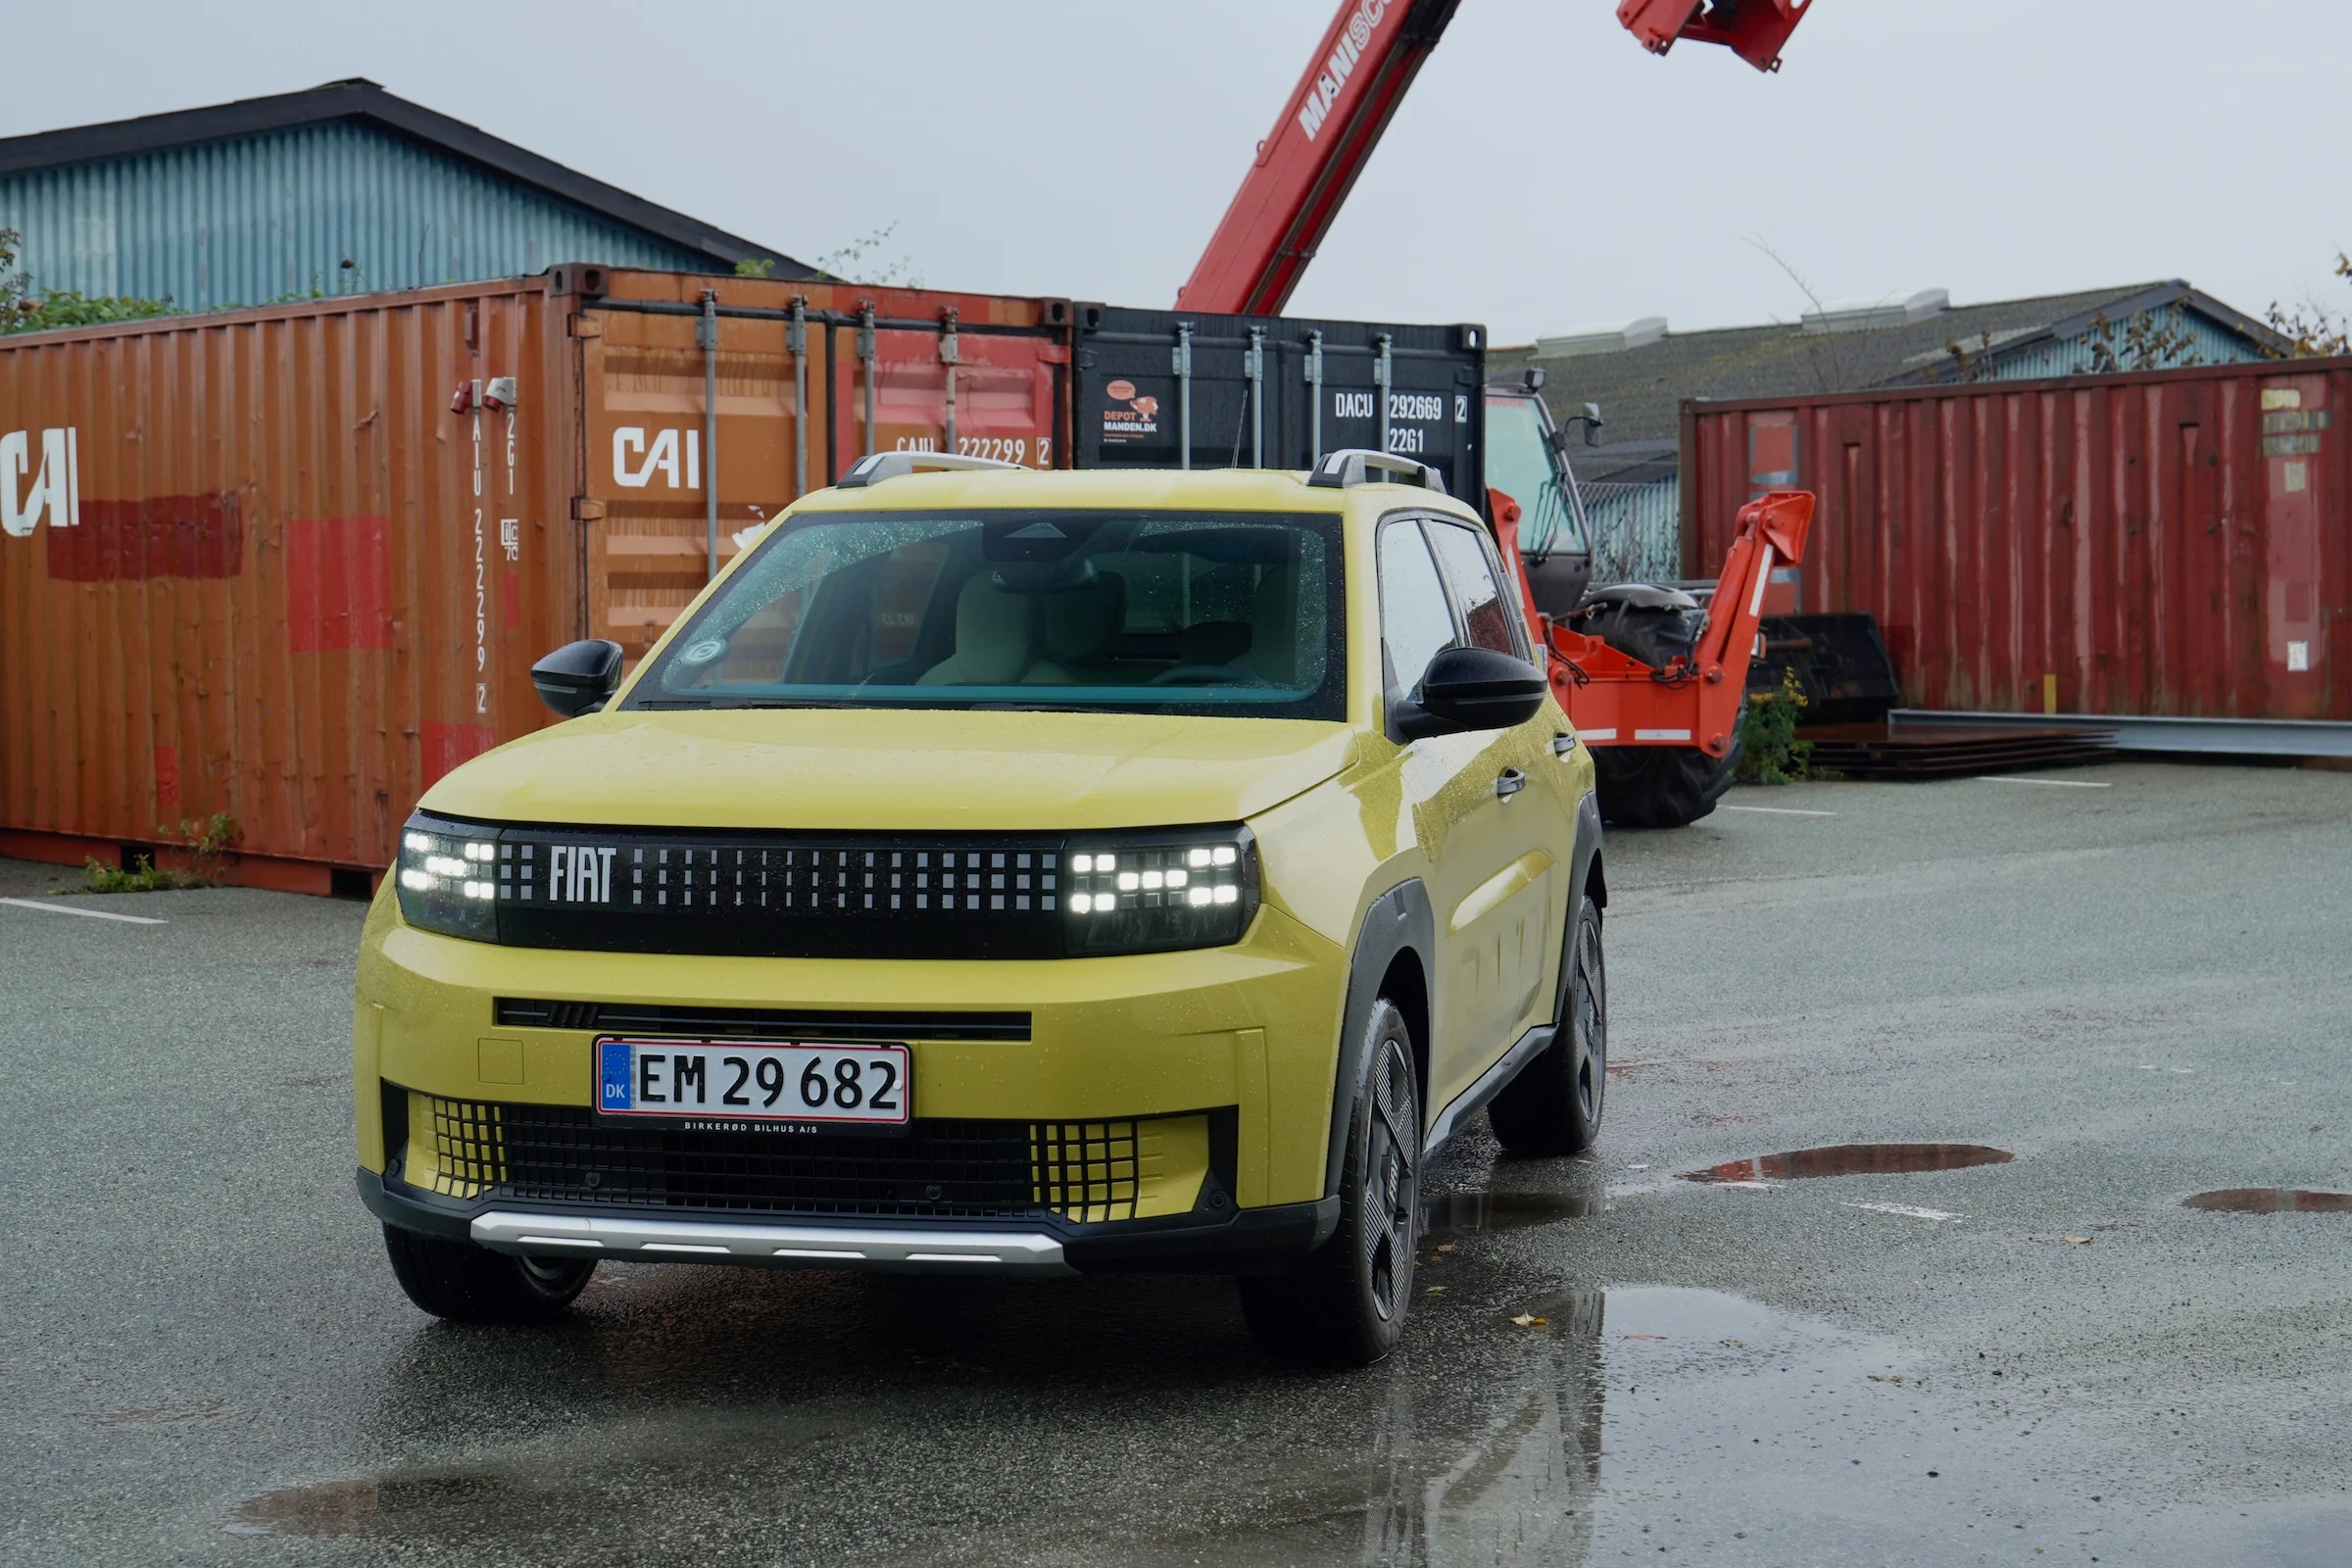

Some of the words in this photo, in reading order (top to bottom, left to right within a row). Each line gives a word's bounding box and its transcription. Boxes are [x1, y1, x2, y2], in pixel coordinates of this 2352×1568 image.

[1298, 0, 1393, 142] MANISC
[1103, 411, 1137, 420] DEPOT
[1103, 421, 1157, 432] MANDEN.DK
[1336, 393, 1373, 417] DACU
[1390, 395, 1443, 420] 292669
[1456, 397, 1466, 421] 2
[472, 416, 482, 496] AIU
[507, 414, 515, 494] 2G1
[612, 426, 700, 489] CAI
[1039, 439, 1050, 466] 2
[1390, 428, 1424, 453] 22G1
[0, 427, 80, 537] CAI
[475, 509, 486, 672] 222299
[478, 685, 486, 711] 2
[549, 846, 617, 903] FIAT
[606, 1084, 625, 1099] DK
[640, 1054, 706, 1103] EM
[722, 1056, 784, 1107] 29
[801, 1056, 897, 1109] 682
[684, 1122, 748, 1131] BIRKERØD
[754, 1124, 795, 1133] BILHUS
